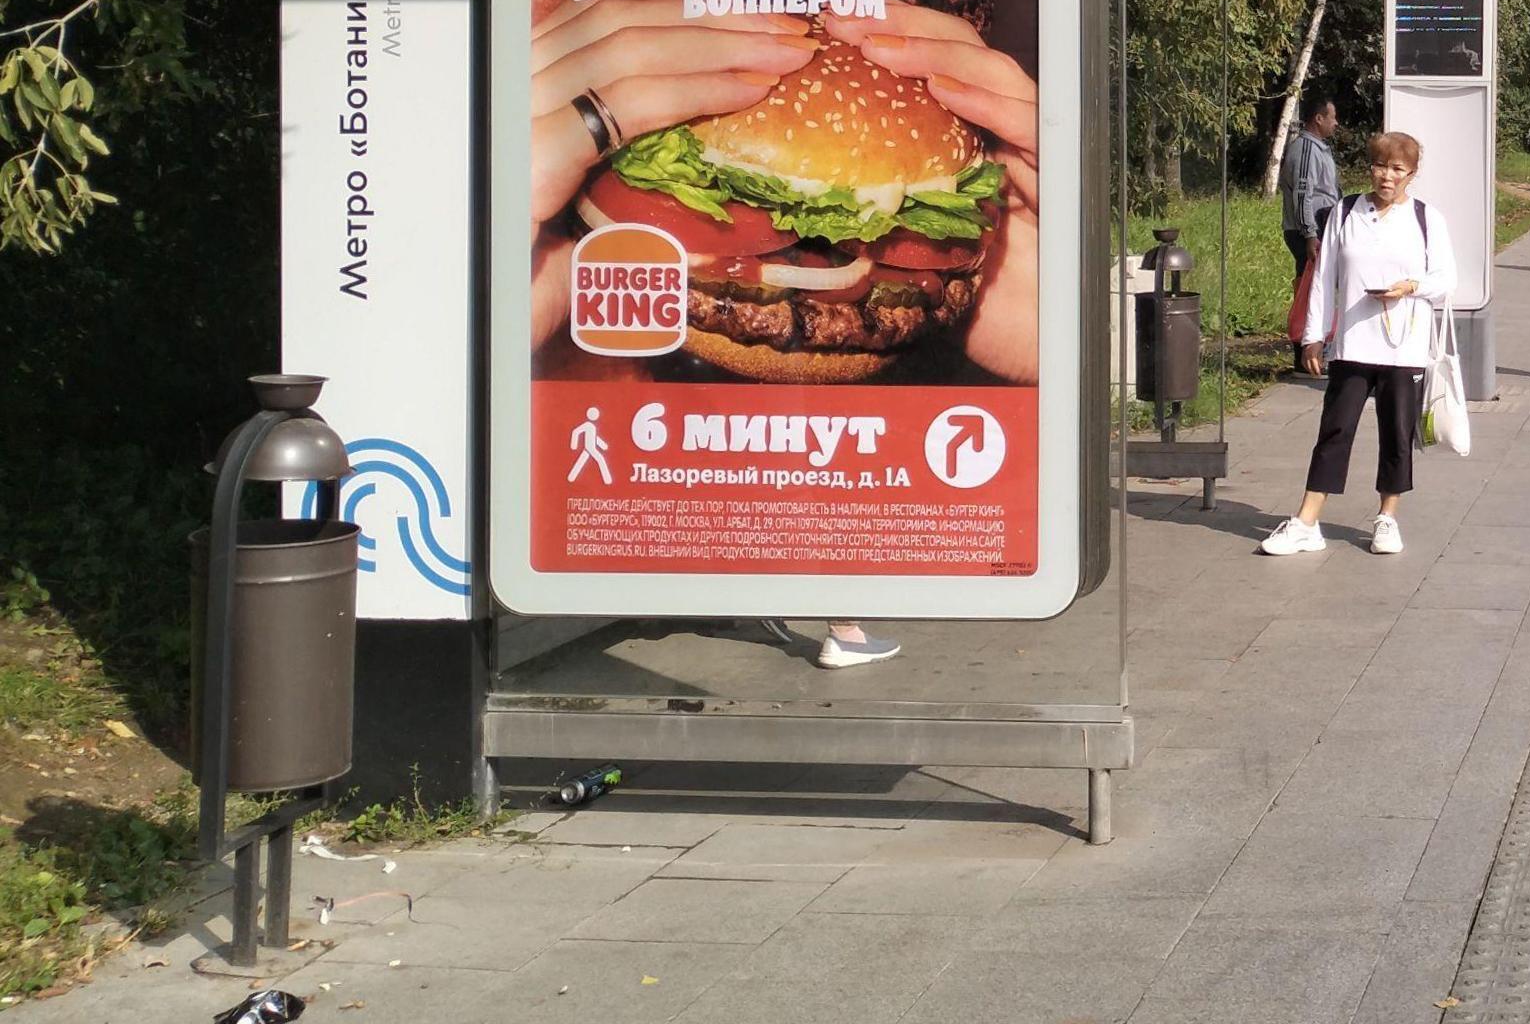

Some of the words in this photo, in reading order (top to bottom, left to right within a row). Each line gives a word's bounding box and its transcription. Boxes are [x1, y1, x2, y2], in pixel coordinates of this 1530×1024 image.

[340, 171, 374, 300] Метро
[577, 266, 682, 292] BURGER
[576, 292, 681, 328] KING
[631, 402, 668, 452] 6
[683, 414, 886, 467] минут
[630, 462, 759, 485] Лазоревый
[762, 466, 854, 489] проезд,
[857, 469, 881, 489] д.
[567, 498, 629, 512] ПРЕДЛОЖЕНИЕ
[630, 497, 675, 513] ДЕЙСТВУЕТ
[676, 500, 689, 513] ДО
[690, 501, 704, 512] ТЕХ
[726, 501, 750, 513] ПОКА
[751, 502, 809, 514] ПРОМОТОВАР
[810, 503, 829, 515] ЕСТЬ
[830, 503, 836, 515] В
[883, 504, 889, 516] В
[891, 504, 944, 516] РЕСТОРАНАХ
[945, 504, 978, 517] «БУРГЕР
[979, 505, 1005, 517] КИНГ»
[567, 528, 579, 540] ОБ
[580, 529, 643, 542] УЧАСТВУЮЩИХ
[644, 530, 692, 543] ПРОДУКТАХ
[700, 531, 730, 544] ДРУГИЕ
[731, 532, 795, 545] ПОДРОБНОСТИ
[795, 532, 844, 546] УТОЧНЯЙТЕ
[849, 533, 910, 548] СОТРУДНИКОВ
[910, 535, 958, 547] РЕСТОРАНА
[966, 536, 978, 547] НА
[979, 533, 1005, 548] САЙТЕ
[649, 542, 692, 558] ВНЕШНИЙ
[692, 546, 710, 560] ВИД
[711, 546, 761, 560] ПРОДУКТОВ
[762, 547, 792, 559] МОЖЕТ
[793, 548, 846, 560] ОТЛИЧАТЬСЯ
[847, 549, 858, 561] ОТ
[859, 549, 936, 563] ПРЕДСТАВЛЕННЫХ
[937, 549, 1004, 563] ИЗОБРАЖЕНИЙ.
